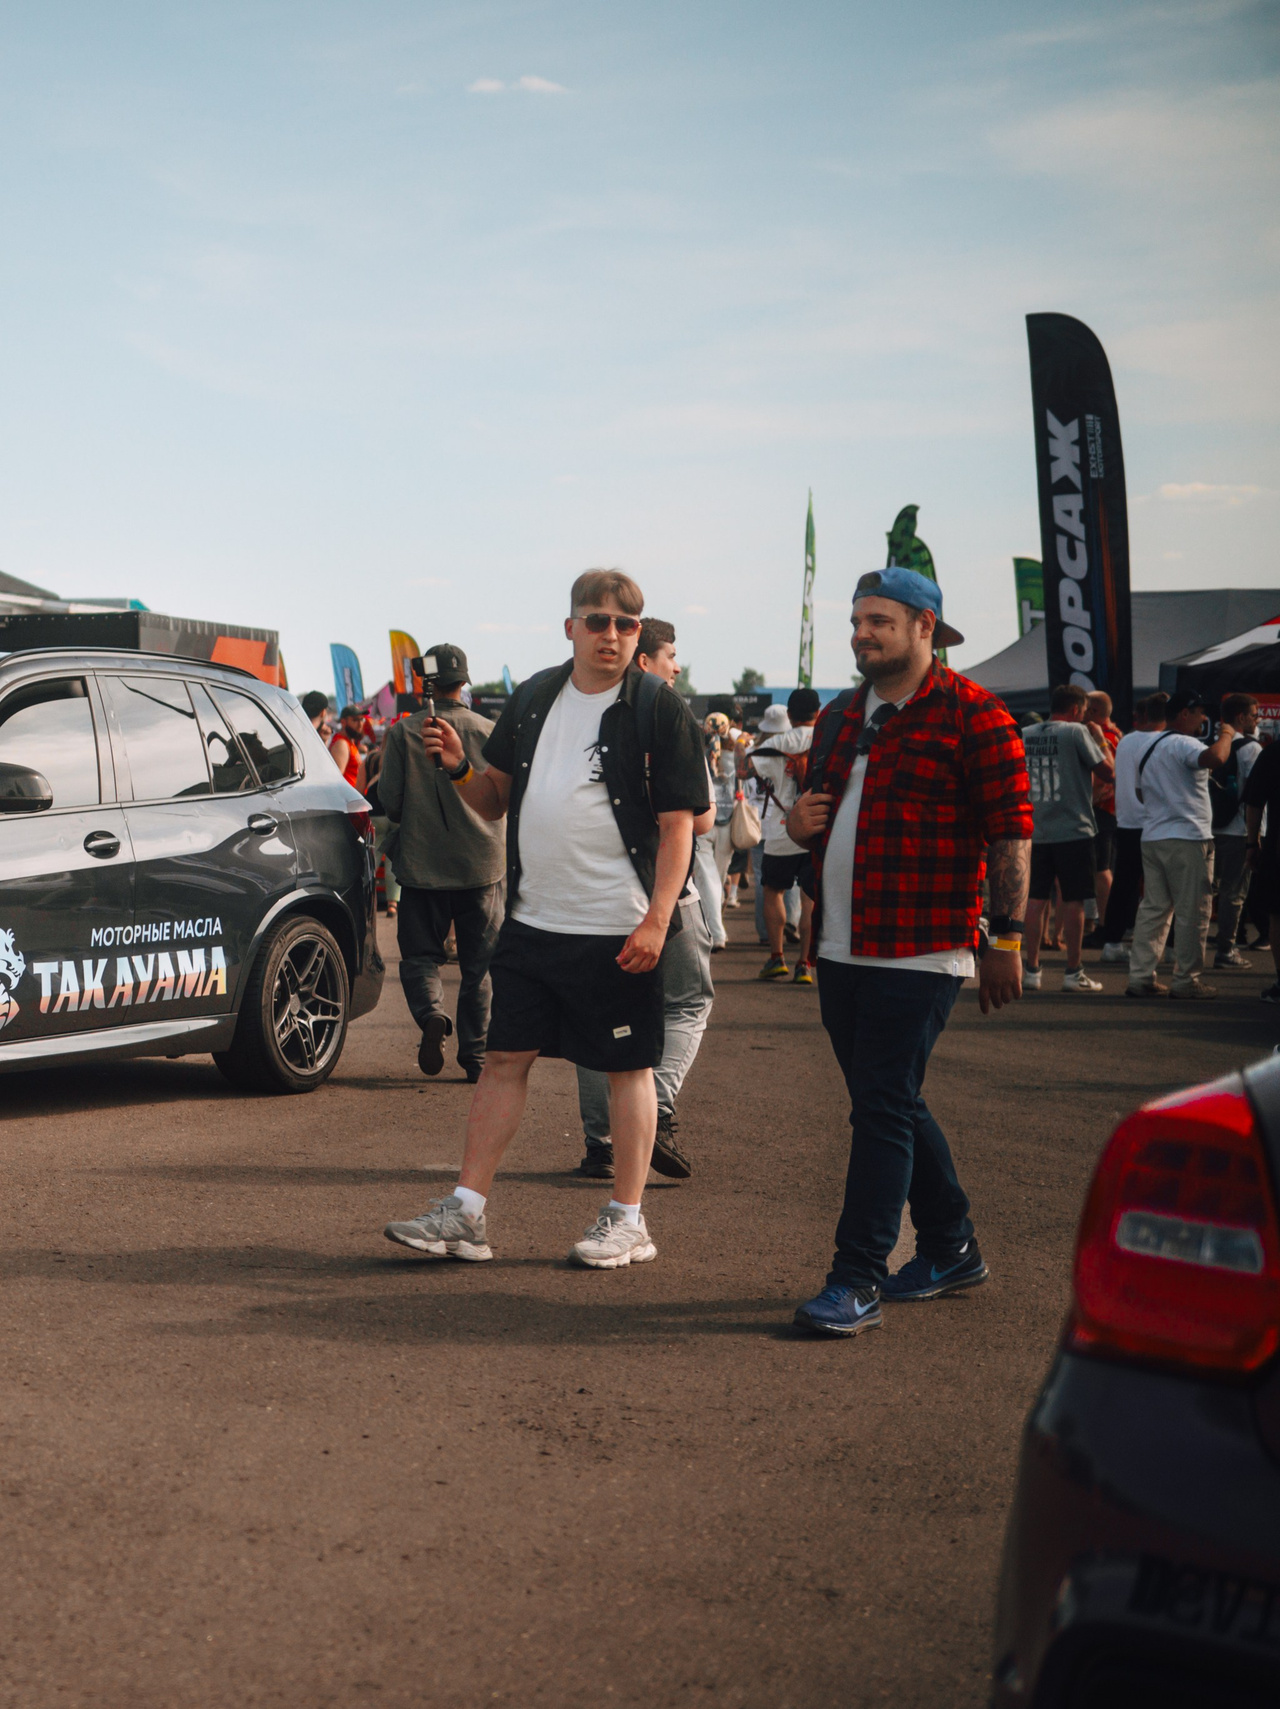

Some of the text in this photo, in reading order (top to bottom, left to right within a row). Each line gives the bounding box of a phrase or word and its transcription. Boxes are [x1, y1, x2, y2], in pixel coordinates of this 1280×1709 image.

[1258, 706, 1280, 718] KAY
[90, 916, 223, 947] МОТОРНЫЕ МАСЛА
[33, 946, 227, 1014] TAKAYAMA
